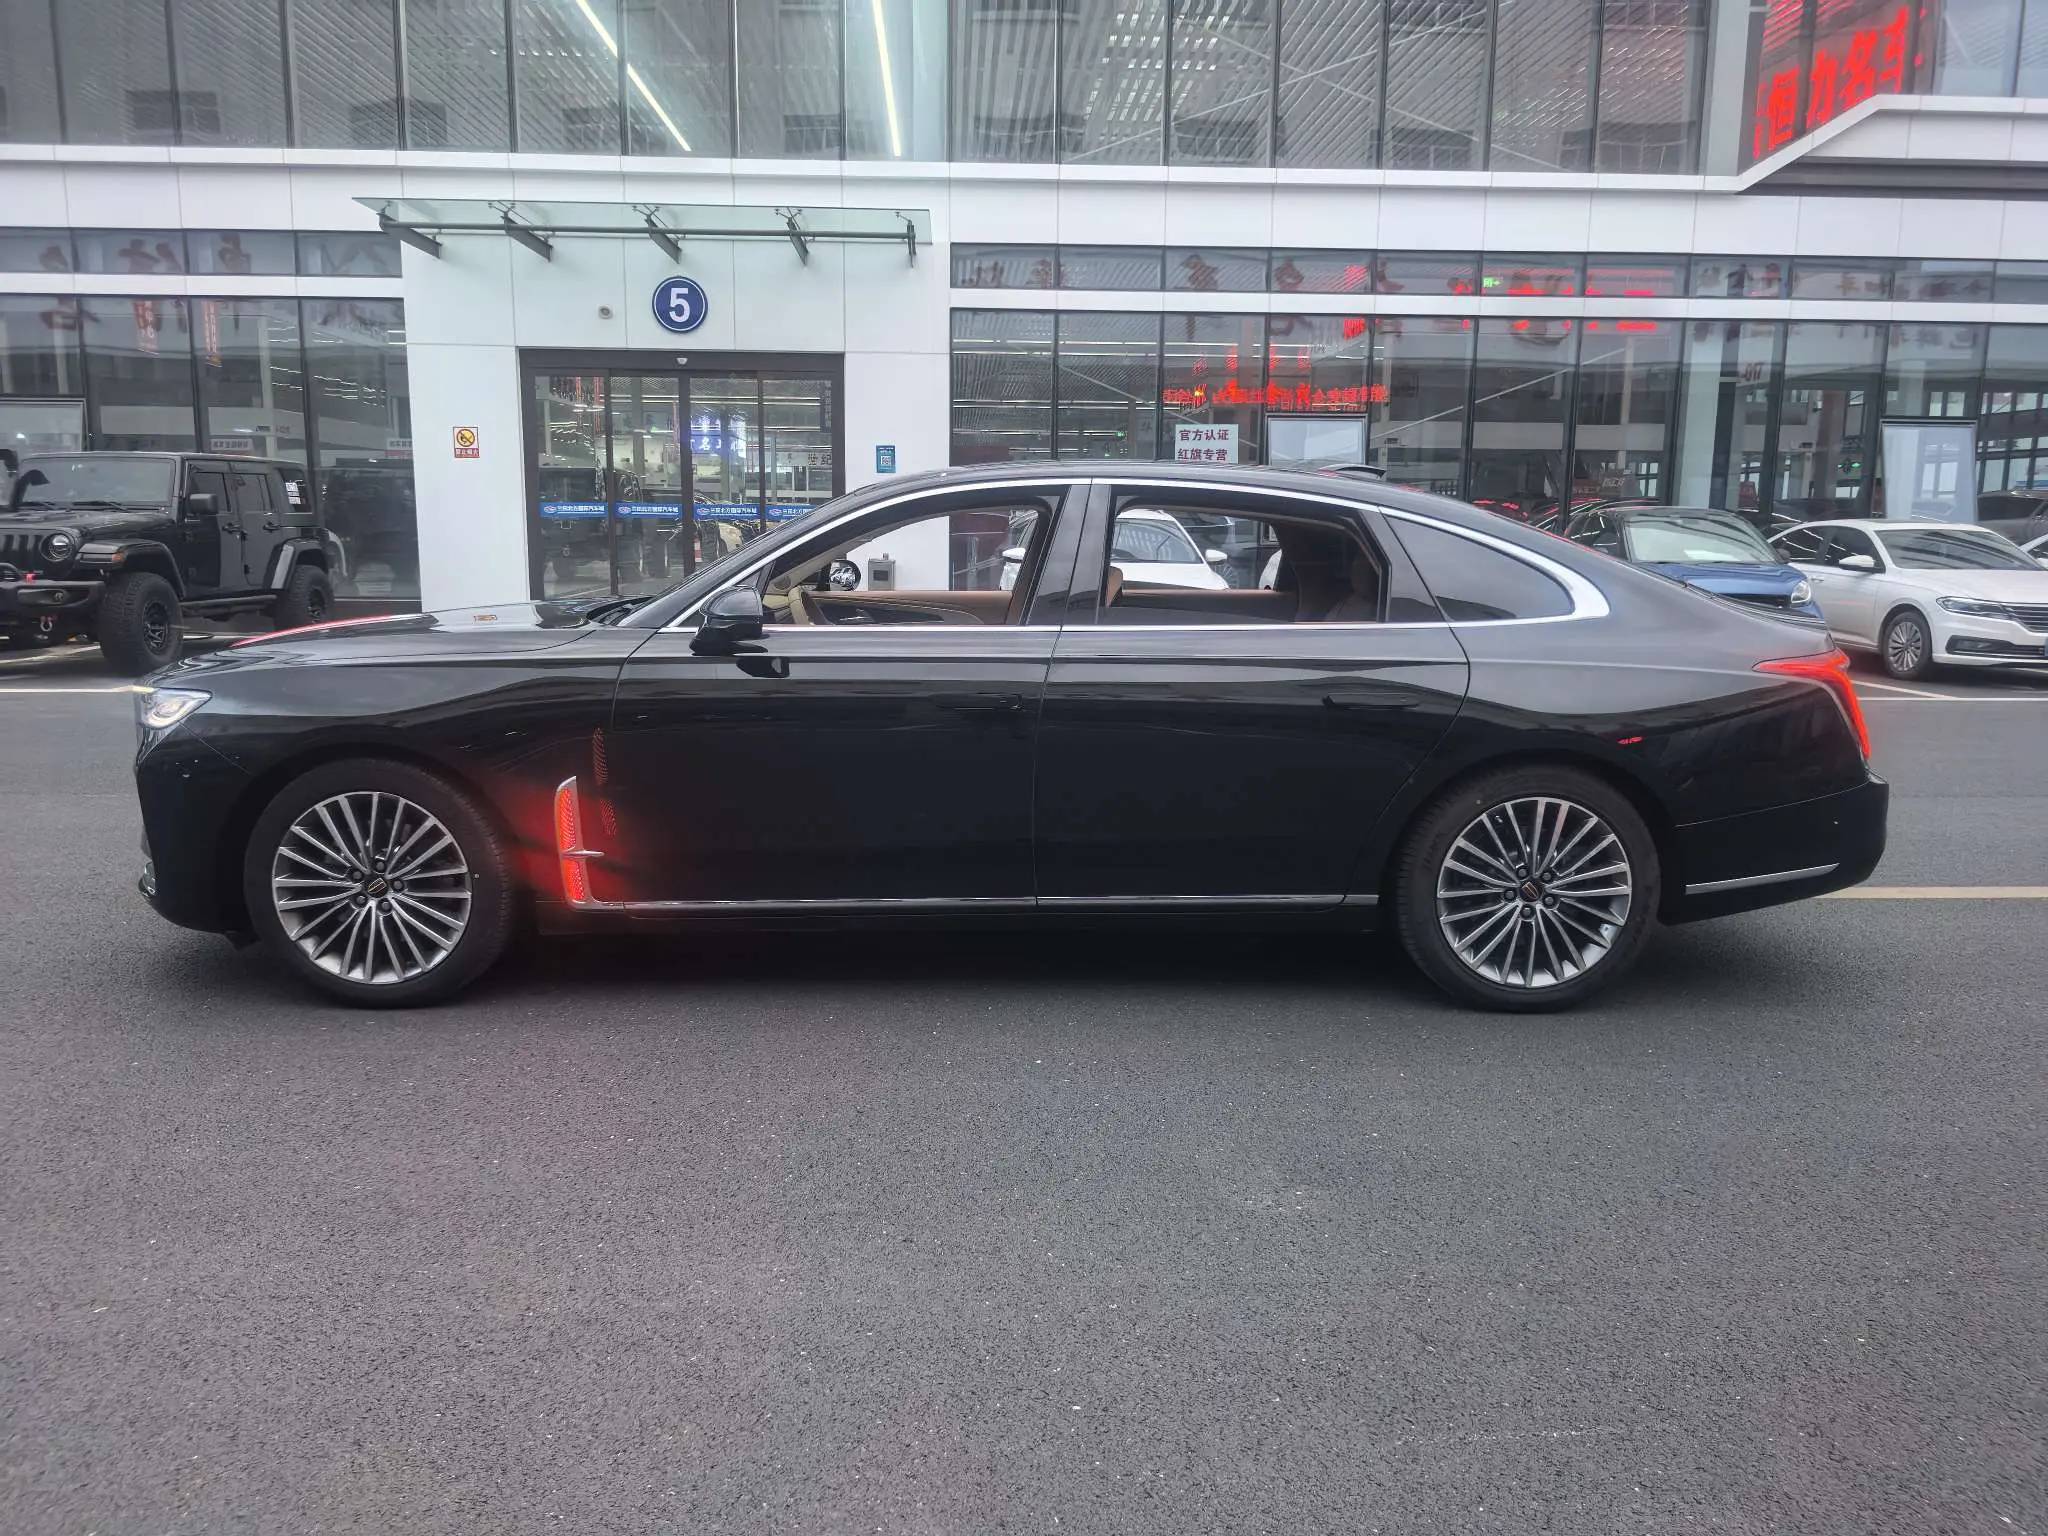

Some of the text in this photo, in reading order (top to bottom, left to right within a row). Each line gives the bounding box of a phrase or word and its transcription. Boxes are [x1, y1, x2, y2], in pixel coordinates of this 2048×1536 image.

[669, 287, 690, 322] 5
[1179, 429, 1230, 441] 官方认证
[1177, 448, 1228, 461] 红旗专营
